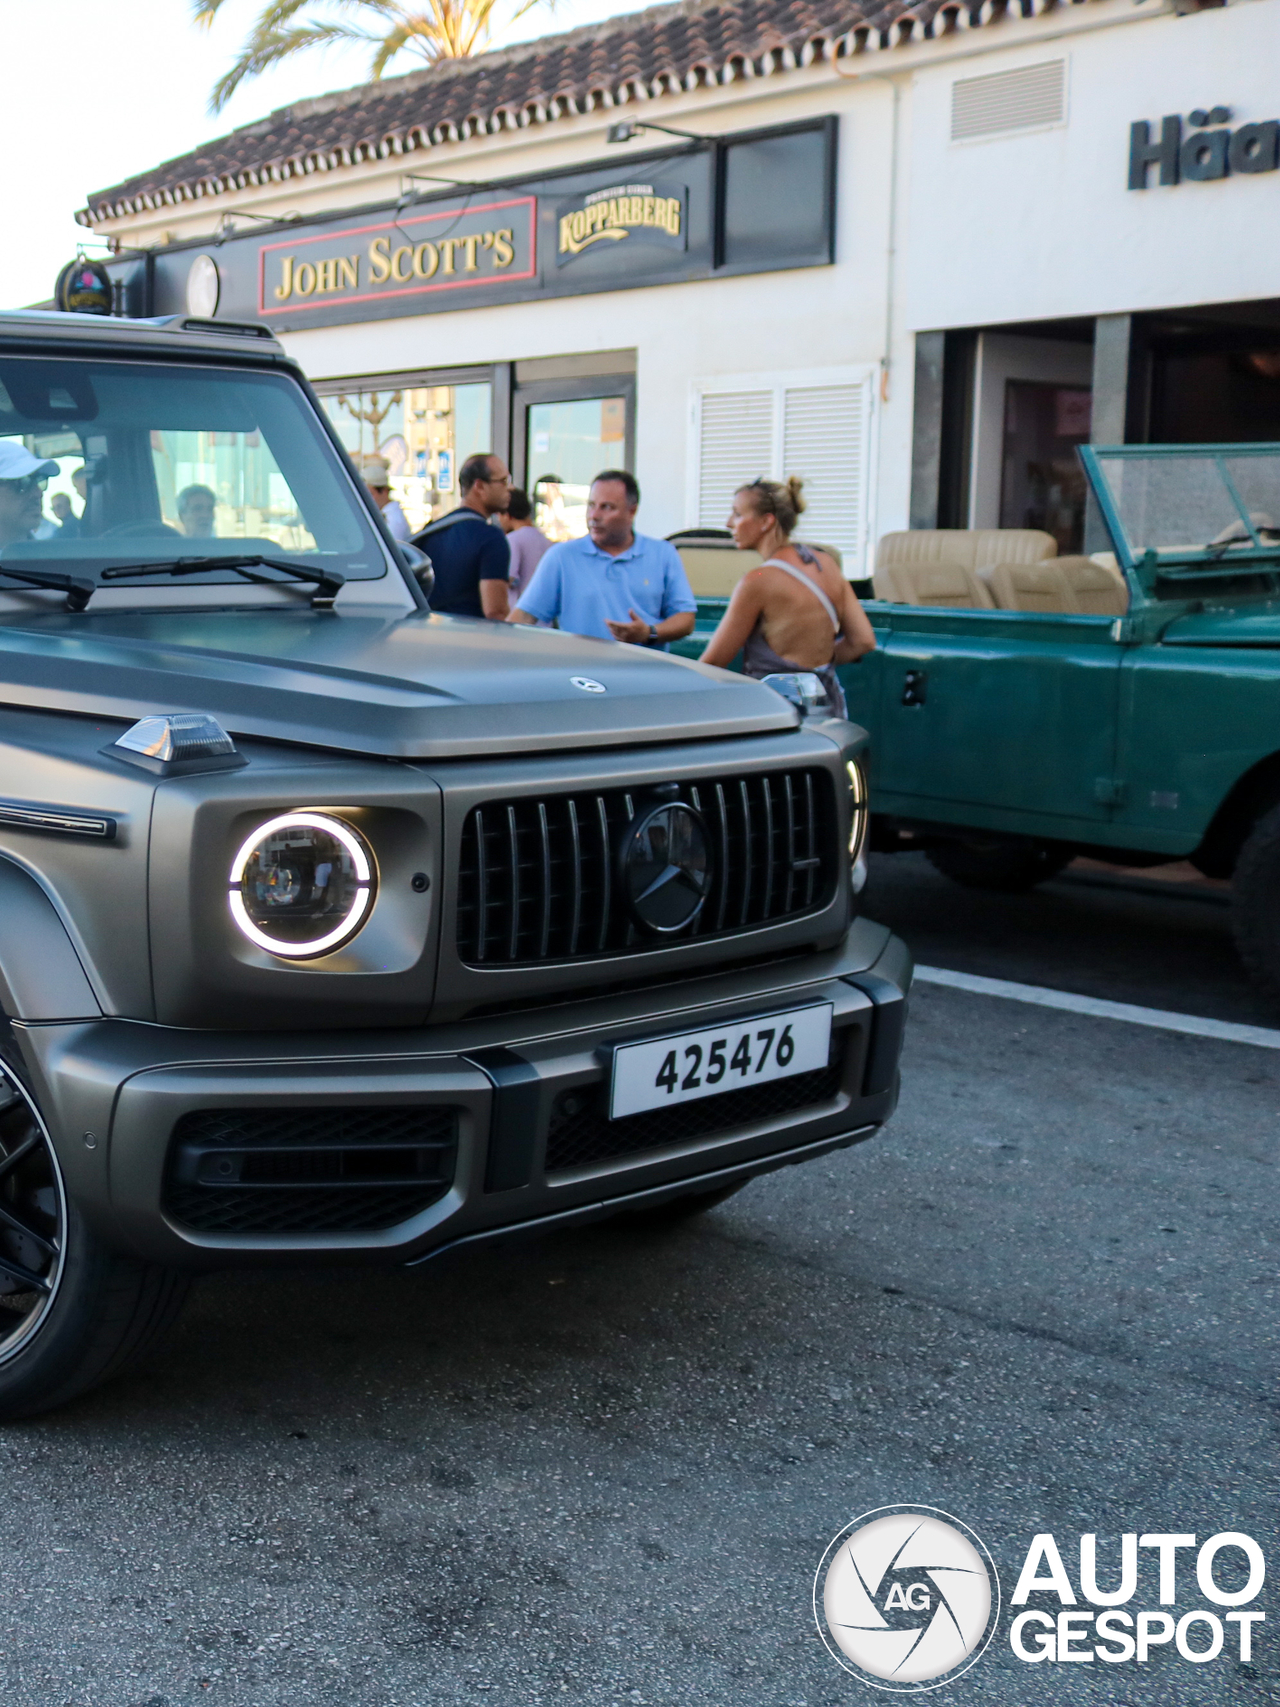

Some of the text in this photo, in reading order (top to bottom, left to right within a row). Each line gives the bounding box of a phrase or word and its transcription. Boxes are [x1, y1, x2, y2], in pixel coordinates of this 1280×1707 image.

[559, 196, 681, 254] KOPPARBERG
[274, 229, 514, 300] JOHN SCOTT'S
[655, 1024, 794, 1094] 425476
